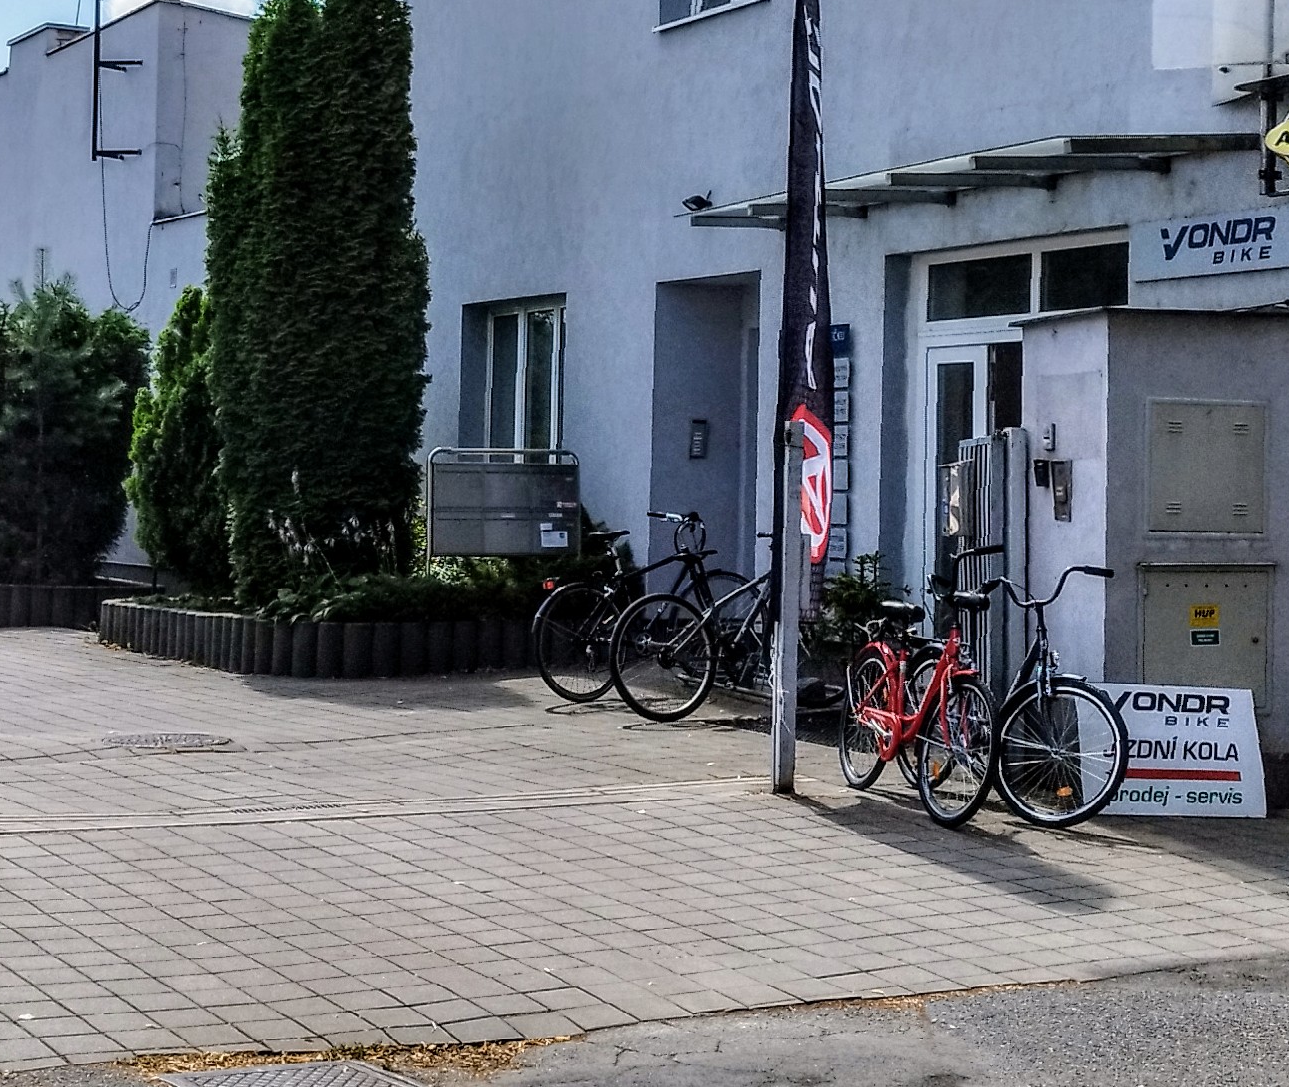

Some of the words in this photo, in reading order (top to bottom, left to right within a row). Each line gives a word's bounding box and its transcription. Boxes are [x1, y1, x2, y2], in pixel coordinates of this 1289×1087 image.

[1160, 216, 1276, 261] VONDR
[1212, 245, 1273, 264] BIKE
[1194, 609, 1215, 618] HUP
[1164, 715, 1230, 728] BIKE
[1182, 740, 1239, 762] KOLA
[1186, 787, 1244, 804] servis
